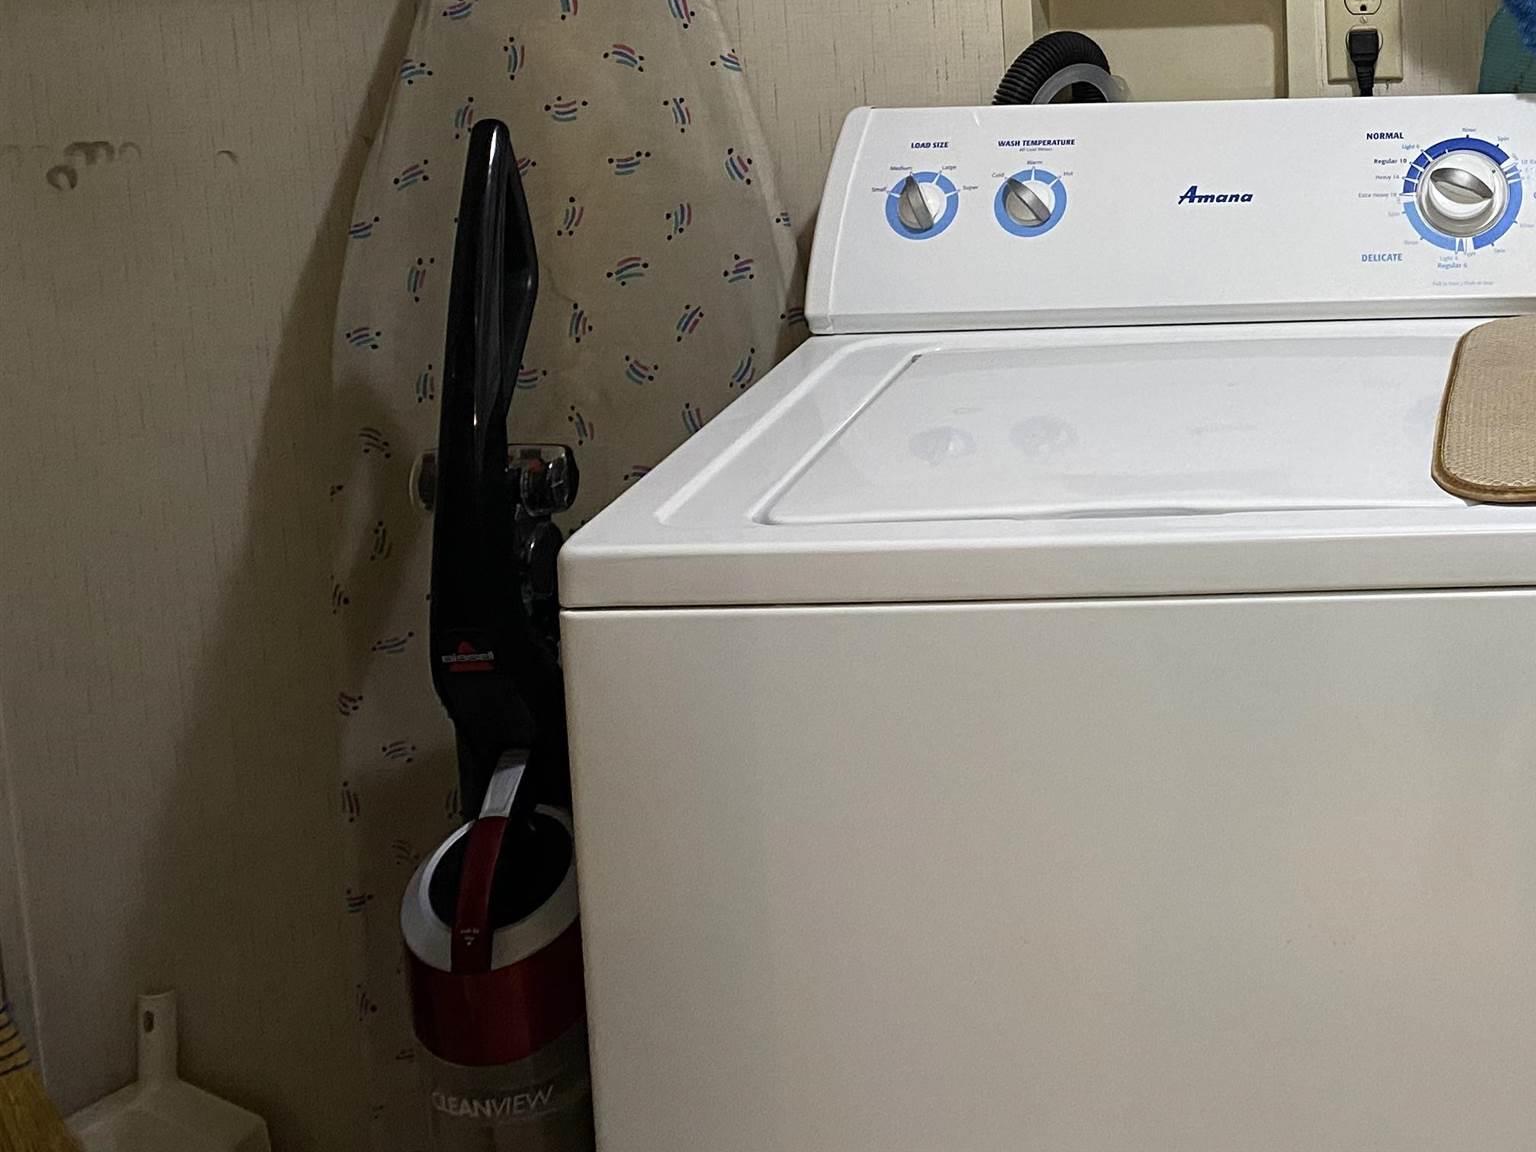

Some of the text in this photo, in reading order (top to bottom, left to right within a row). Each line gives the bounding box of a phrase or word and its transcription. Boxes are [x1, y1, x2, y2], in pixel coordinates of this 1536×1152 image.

[1366, 132, 1404, 140] NORMAL
[1178, 185, 1253, 205] Amana
[1361, 253, 1403, 262] DELICATE
